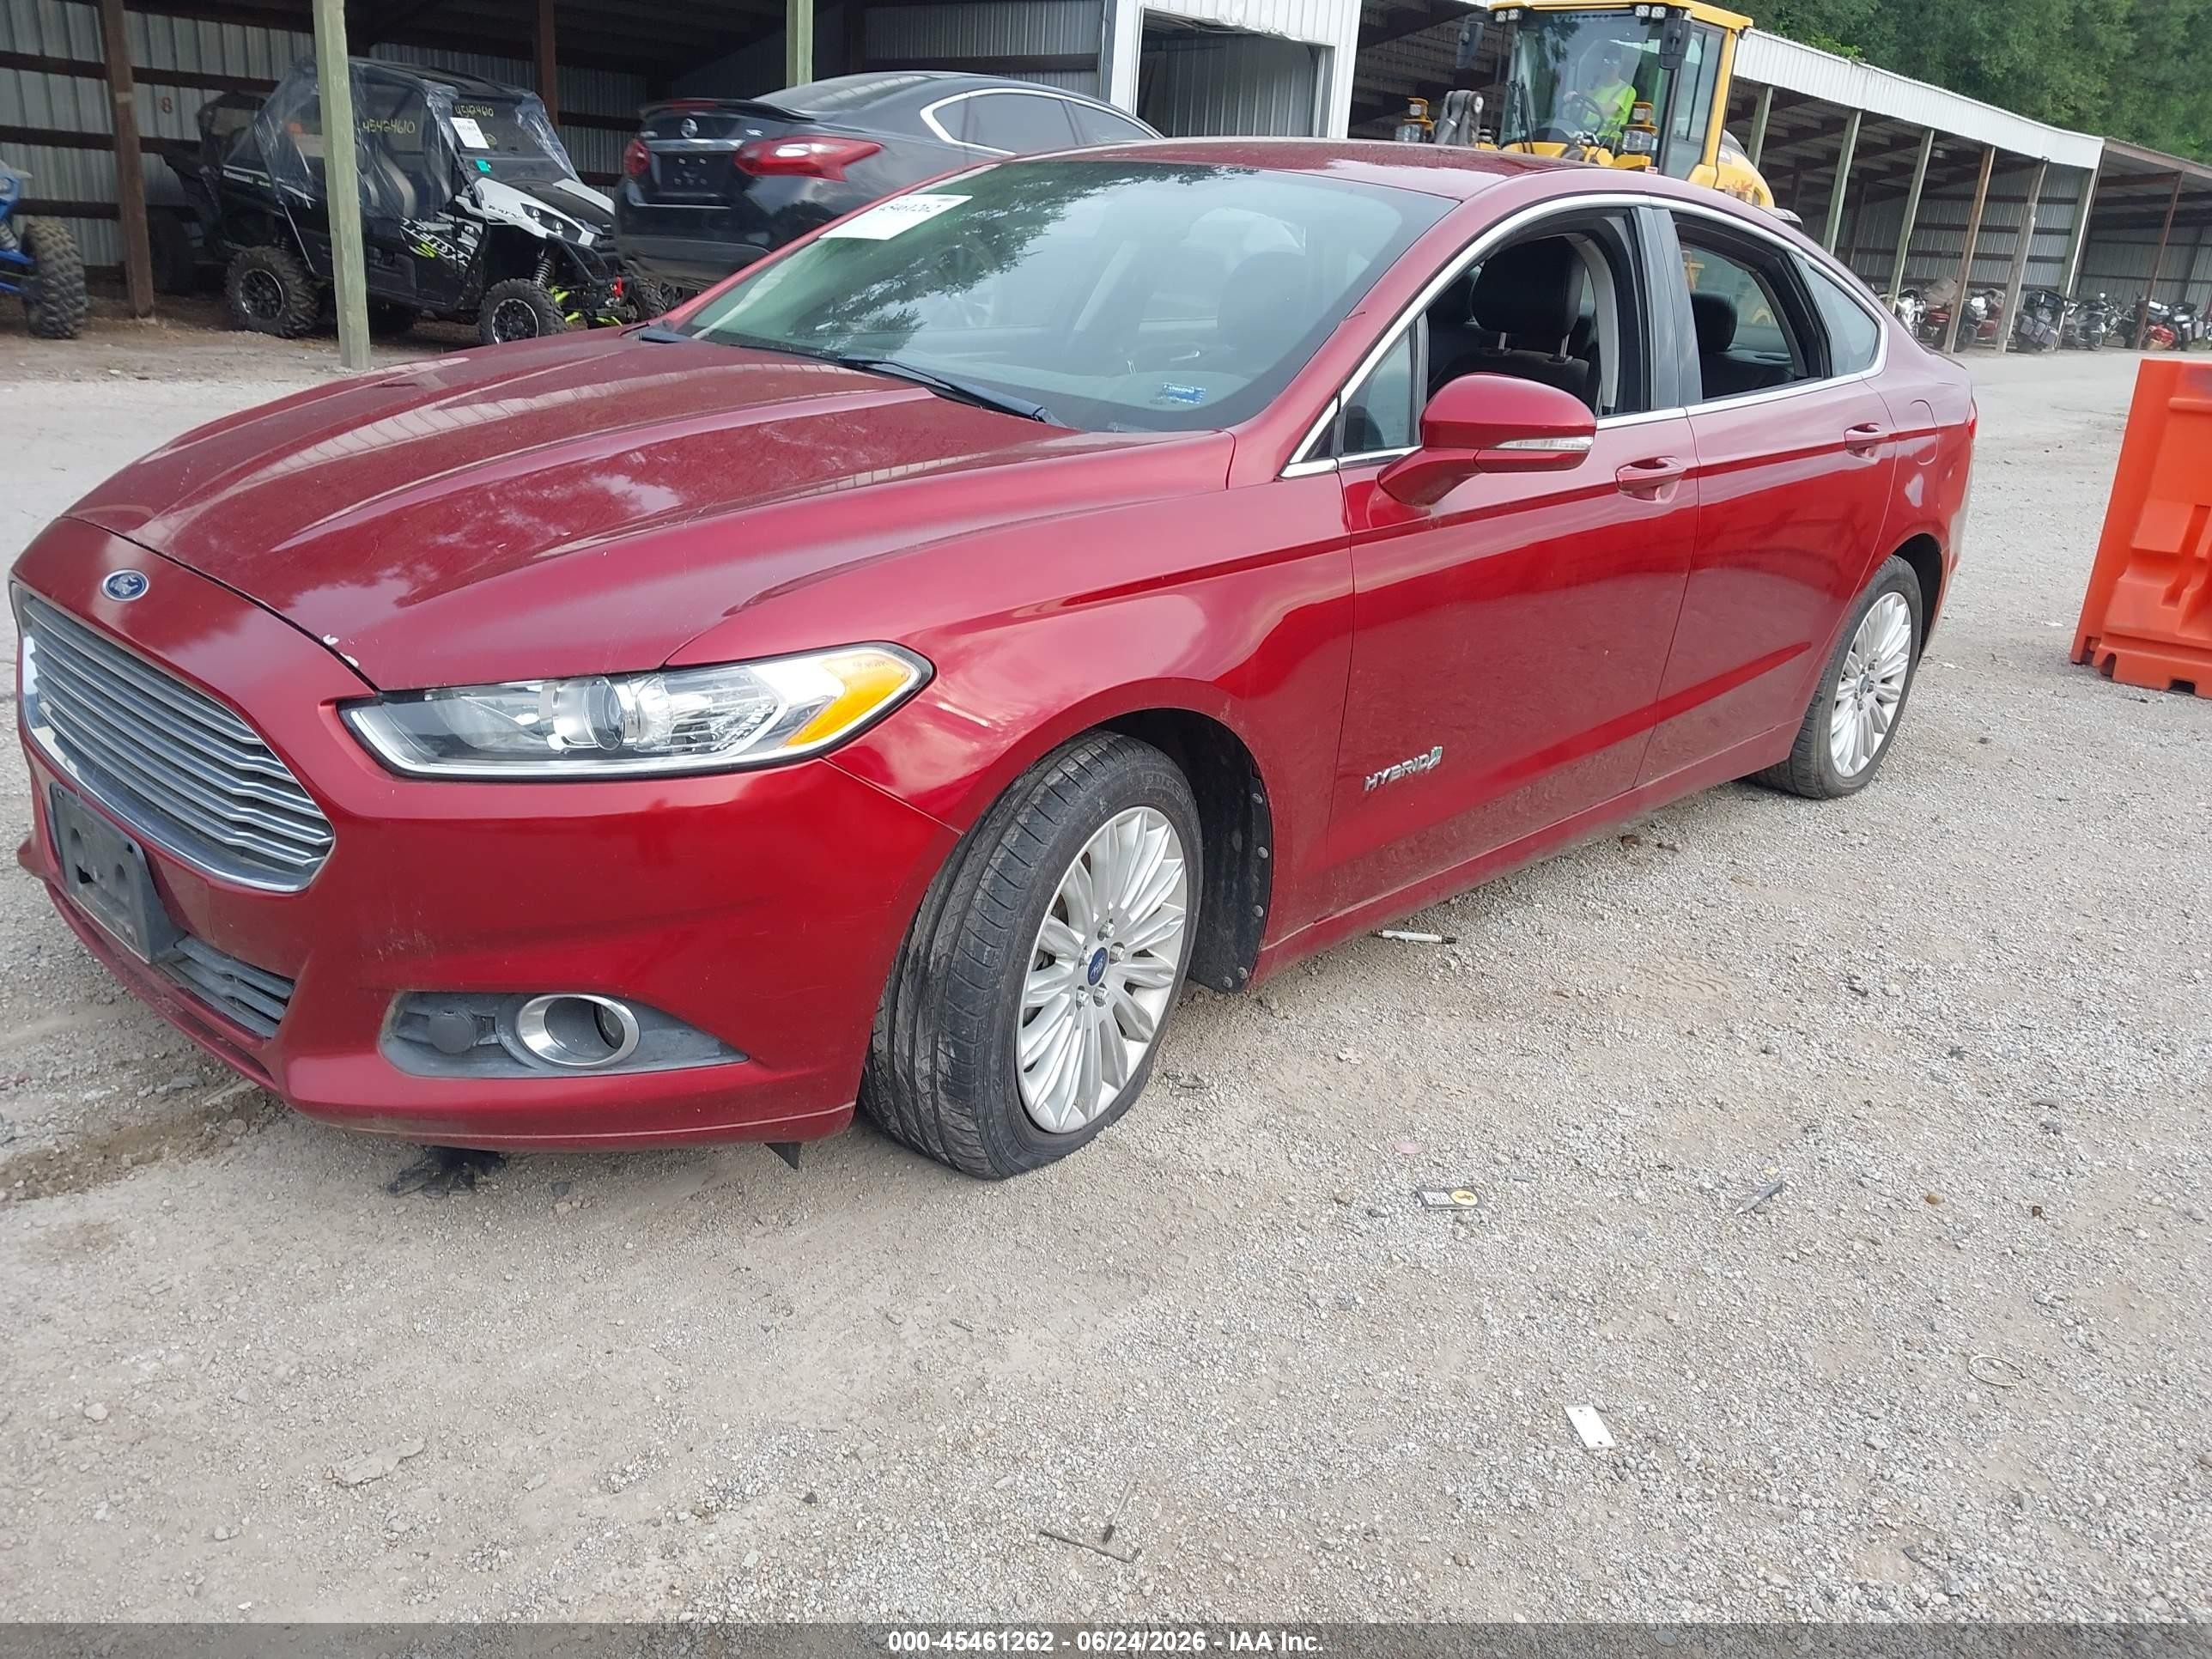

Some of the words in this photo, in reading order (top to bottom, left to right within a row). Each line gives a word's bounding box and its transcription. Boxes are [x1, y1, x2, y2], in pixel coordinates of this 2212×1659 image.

[161, 96, 173, 114] 8
[362, 118, 416, 135] 45424610
[1363, 753, 1430, 791] HYBRID
[1090, 955, 1106, 978] Ford
